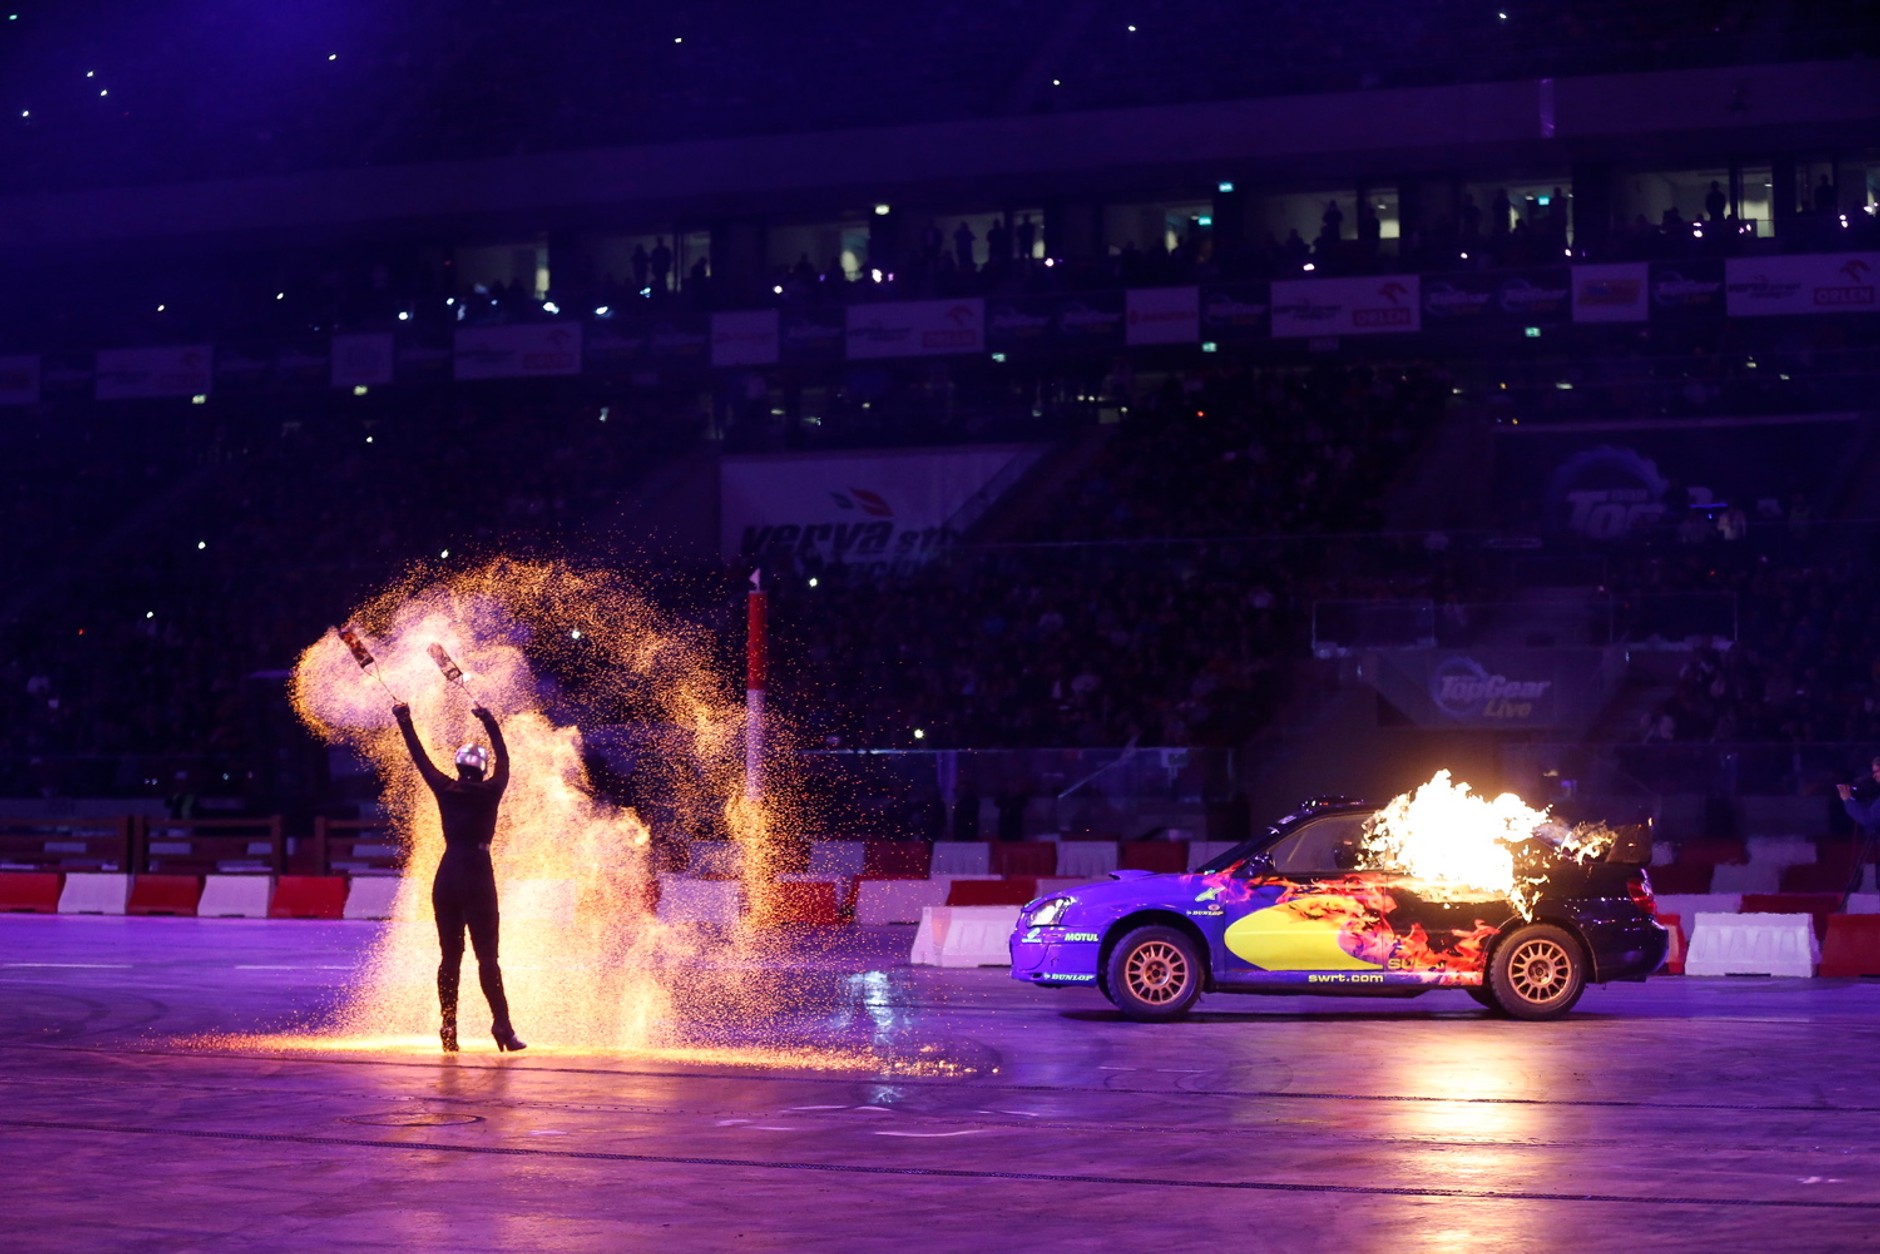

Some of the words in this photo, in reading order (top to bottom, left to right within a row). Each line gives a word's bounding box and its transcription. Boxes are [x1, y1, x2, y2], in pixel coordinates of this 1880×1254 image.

[1816, 286, 1873, 305] ORLEN
[741, 521, 893, 555] verva
[1440, 673, 1551, 703] TopGear
[1482, 699, 1532, 719] Live
[1064, 933, 1099, 942] MOTUL
[1051, 973, 1095, 982] DUNLOP
[1308, 974, 1384, 983] swrt.com
